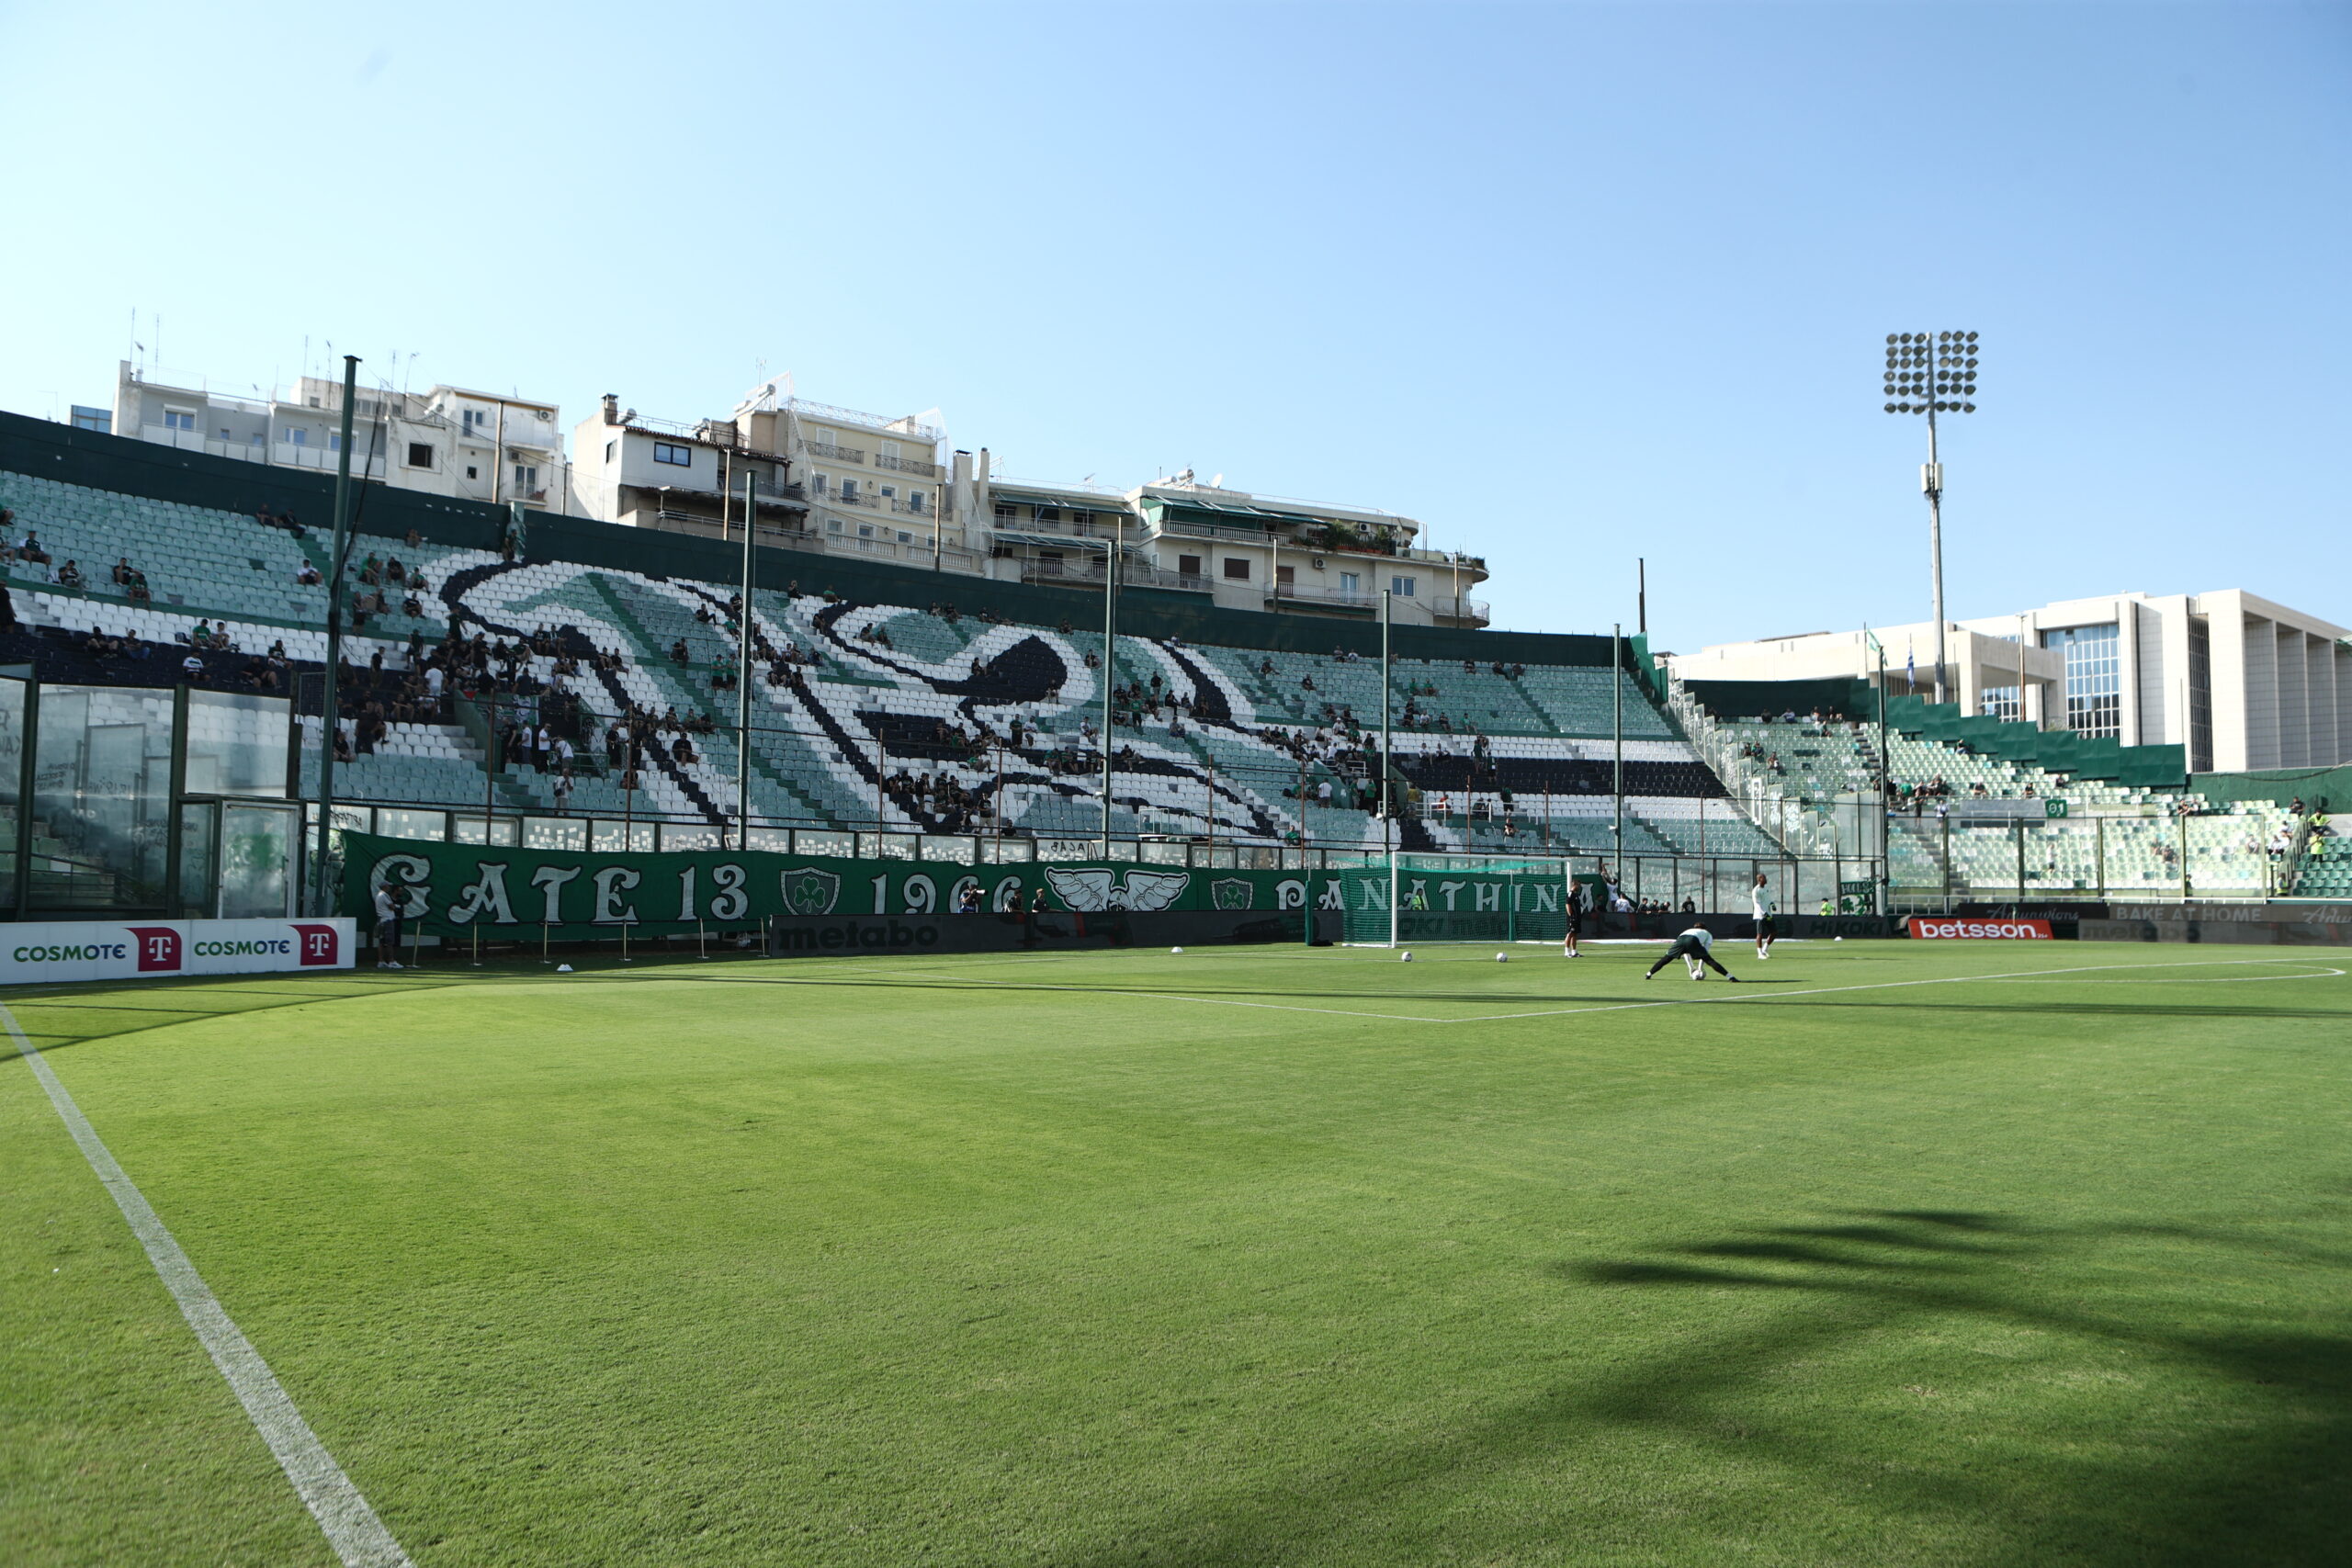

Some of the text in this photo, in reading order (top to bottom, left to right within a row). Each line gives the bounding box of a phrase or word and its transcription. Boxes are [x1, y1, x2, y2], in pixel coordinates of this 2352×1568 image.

[370, 853, 642, 925] GATE
[678, 863, 749, 920] 13
[2116, 907, 2263, 922] BAKE AT HOME
[777, 922, 940, 952] metabo
[1919, 919, 2036, 939] betsson
[14, 944, 126, 963] COSMOTE
[194, 940, 290, 956] COSMOTE
